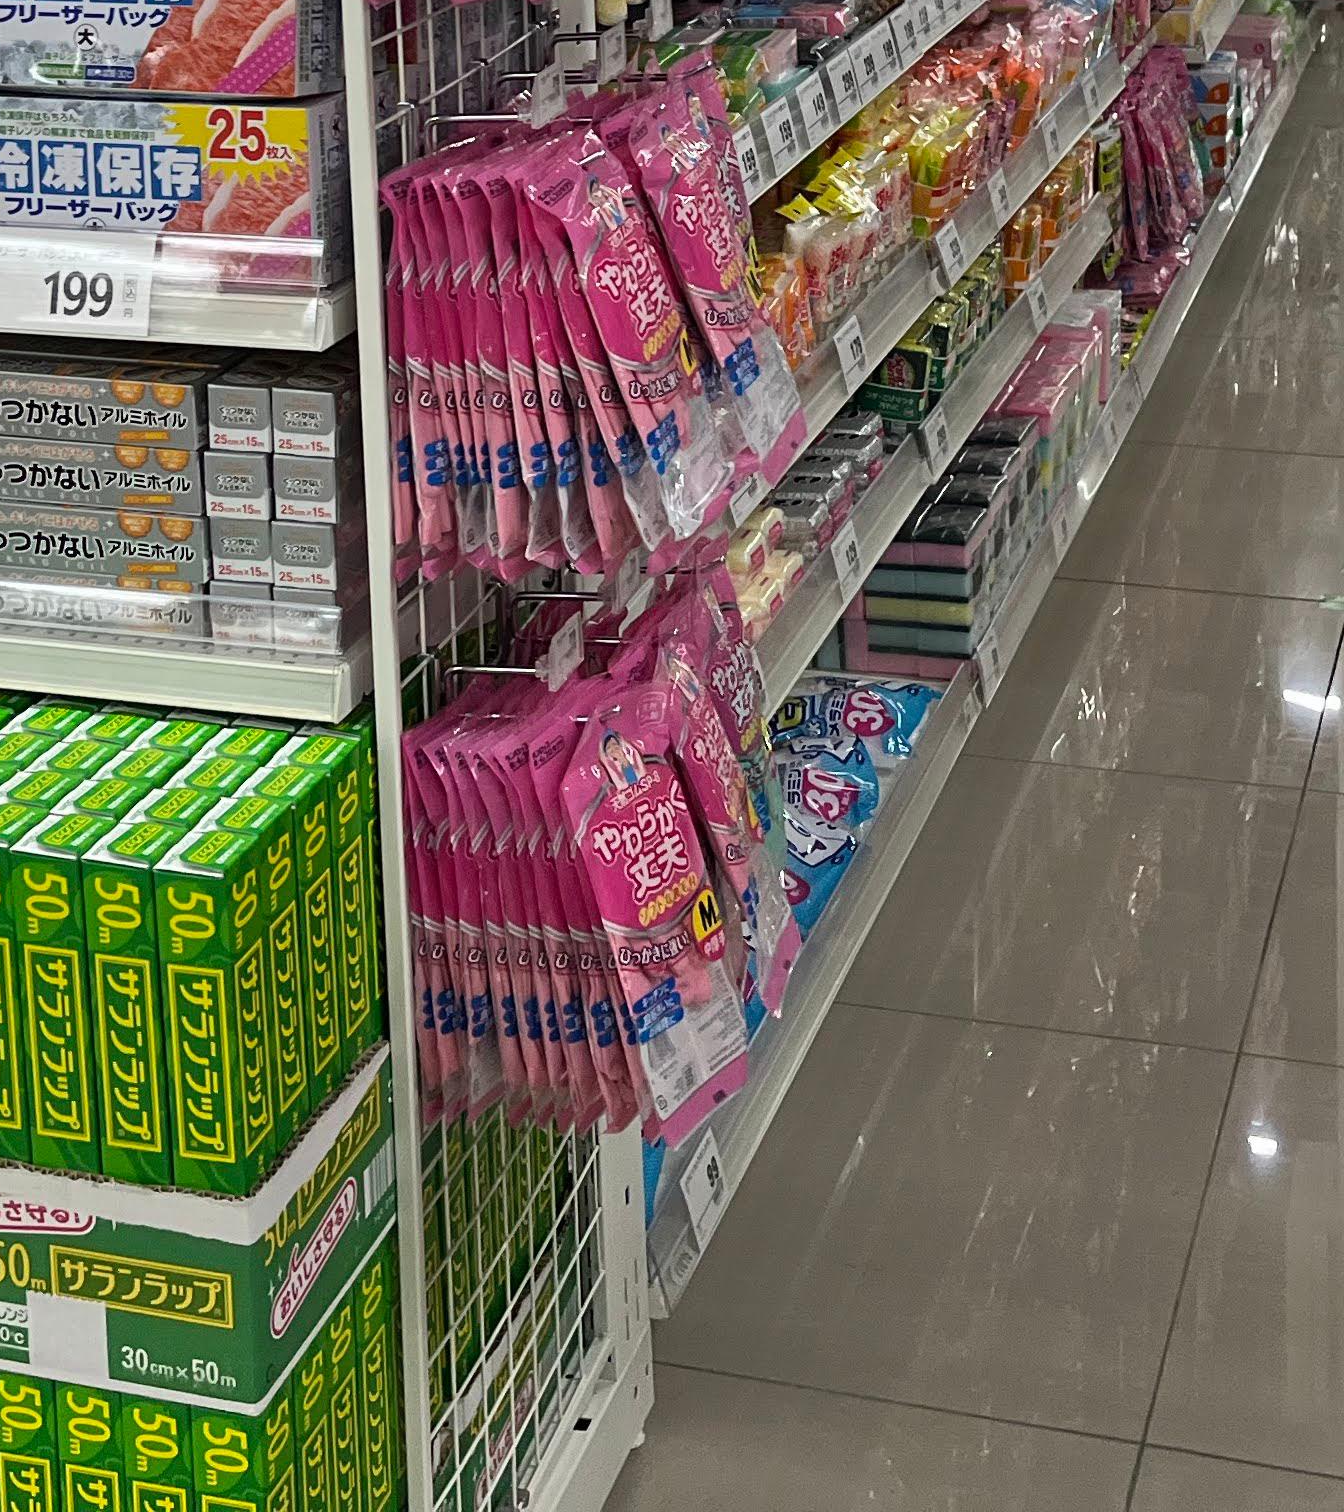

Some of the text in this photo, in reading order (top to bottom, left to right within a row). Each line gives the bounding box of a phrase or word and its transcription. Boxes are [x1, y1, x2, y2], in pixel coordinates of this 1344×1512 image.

[77, 28, 94, 45] 大
[44, 270, 114, 318] 199
[213, 433, 265, 448] 25cm×15m
[278, 438, 331, 453] 25cm×15m
[593, 778, 689, 862] やわらかく
[628, 834, 689, 901] 丈夫
[698, 894, 718, 932] M
[167, 885, 226, 1153] 50m サランラップ
[59, 1258, 222, 1316] サランラップ
[120, 1345, 237, 1389] 30cm×50m
